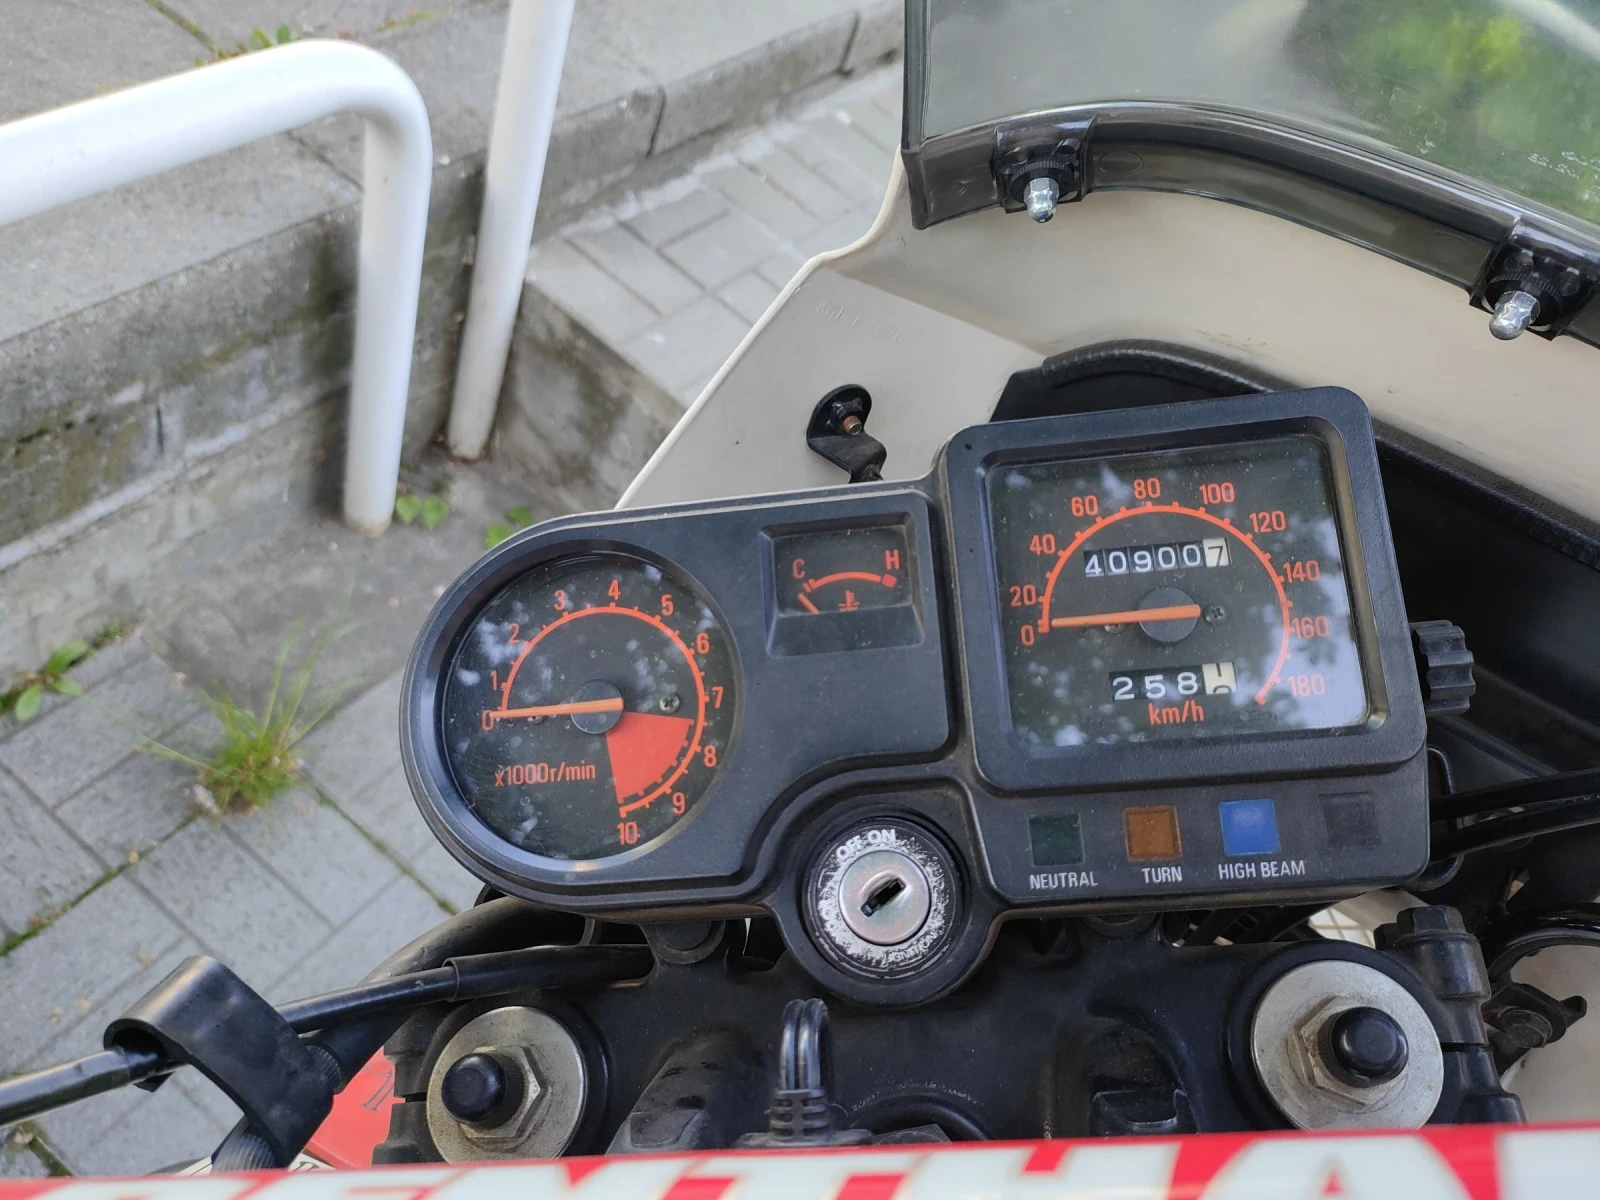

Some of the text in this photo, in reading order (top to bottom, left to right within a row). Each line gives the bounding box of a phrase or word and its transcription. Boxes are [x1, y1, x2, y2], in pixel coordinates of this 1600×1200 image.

[1133, 477, 1161, 499] 80
[1199, 481, 1235, 504] 100
[1071, 494, 1098, 517] 60
[1249, 510, 1286, 532] 120
[1029, 533, 1056, 556] 40
[792, 558, 806, 579] C
[885, 549, 900, 570] H
[1084, 545, 1226, 577] 409007
[1283, 560, 1320, 583] 140
[554, 589, 565, 610] 3
[608, 580, 621, 600] 4
[1010, 584, 1037, 607] 20
[661, 594, 674, 616] 5
[508, 623, 520, 644] 2
[1020, 624, 1035, 646] 0
[1293, 615, 1330, 639] 160
[697, 633, 710, 654] 6
[490, 670, 498, 691] 1
[1288, 673, 1326, 697] 180
[711, 686, 724, 708] 7
[482, 710, 494, 731] 0
[1148, 700, 1205, 726] km/h
[703, 745, 717, 767] 8
[672, 792, 685, 814] 9
[617, 821, 639, 845] 10
[867, 828, 896, 845] ON
[1029, 870, 1099, 891] NEUTRAL
[1141, 866, 1183, 885] TURN
[1218, 858, 1306, 881] HIGH BEAM
